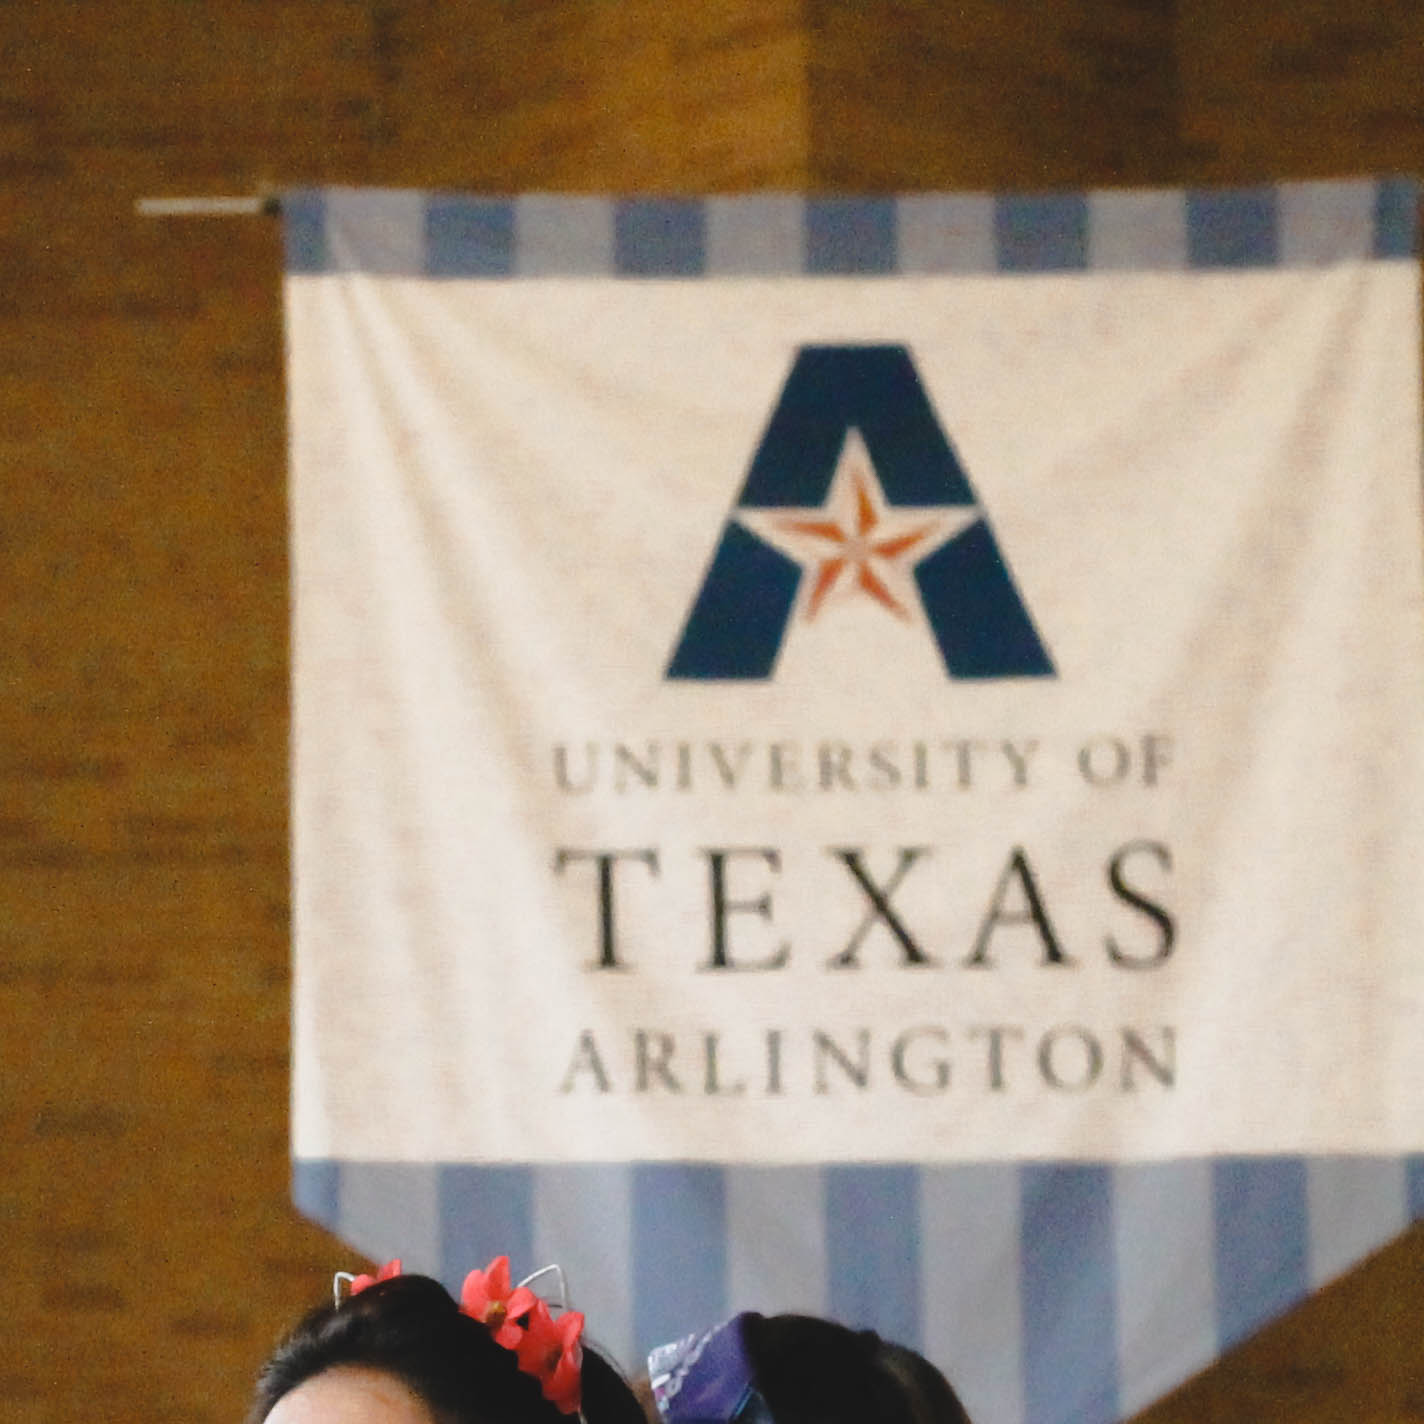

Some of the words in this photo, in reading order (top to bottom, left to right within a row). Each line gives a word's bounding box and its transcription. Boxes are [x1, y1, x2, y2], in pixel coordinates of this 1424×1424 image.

[552, 737, 1041, 796] UNIVERSITY
[1077, 733, 1176, 791] OF
[554, 838, 1180, 975] TEXAS
[560, 1022, 1179, 1097] ARLINGTON
